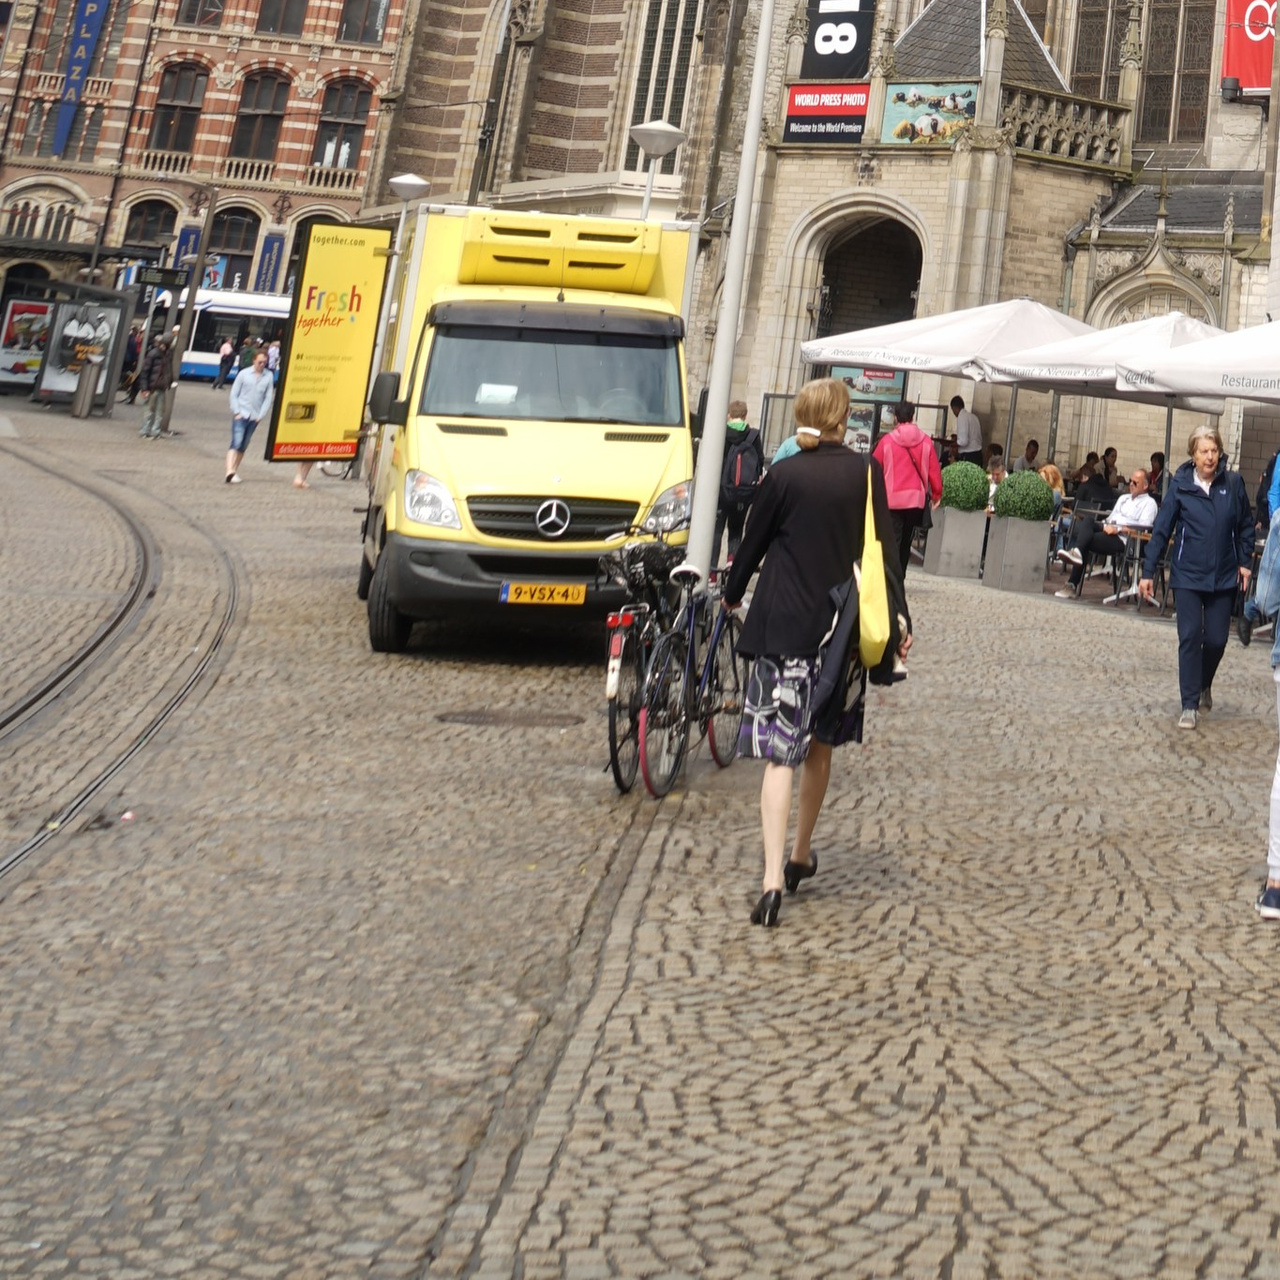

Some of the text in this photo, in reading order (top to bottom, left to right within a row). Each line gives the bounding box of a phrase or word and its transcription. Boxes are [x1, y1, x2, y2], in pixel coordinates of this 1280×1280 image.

[64, 2, 98, 102] PLAZA
[794, 92, 867, 106] WORLD PRESS PHOTO
[789, 121, 862, 133] Welcome to the World Premiere
[312, 234, 366, 248] together.com
[305, 284, 363, 313] Fresh
[296, 306, 345, 337] together
[990, 366, 1034, 376] Restaurant
[1045, 367, 1081, 376] Nieuwe
[1221, 373, 1280, 390] Restaurant
